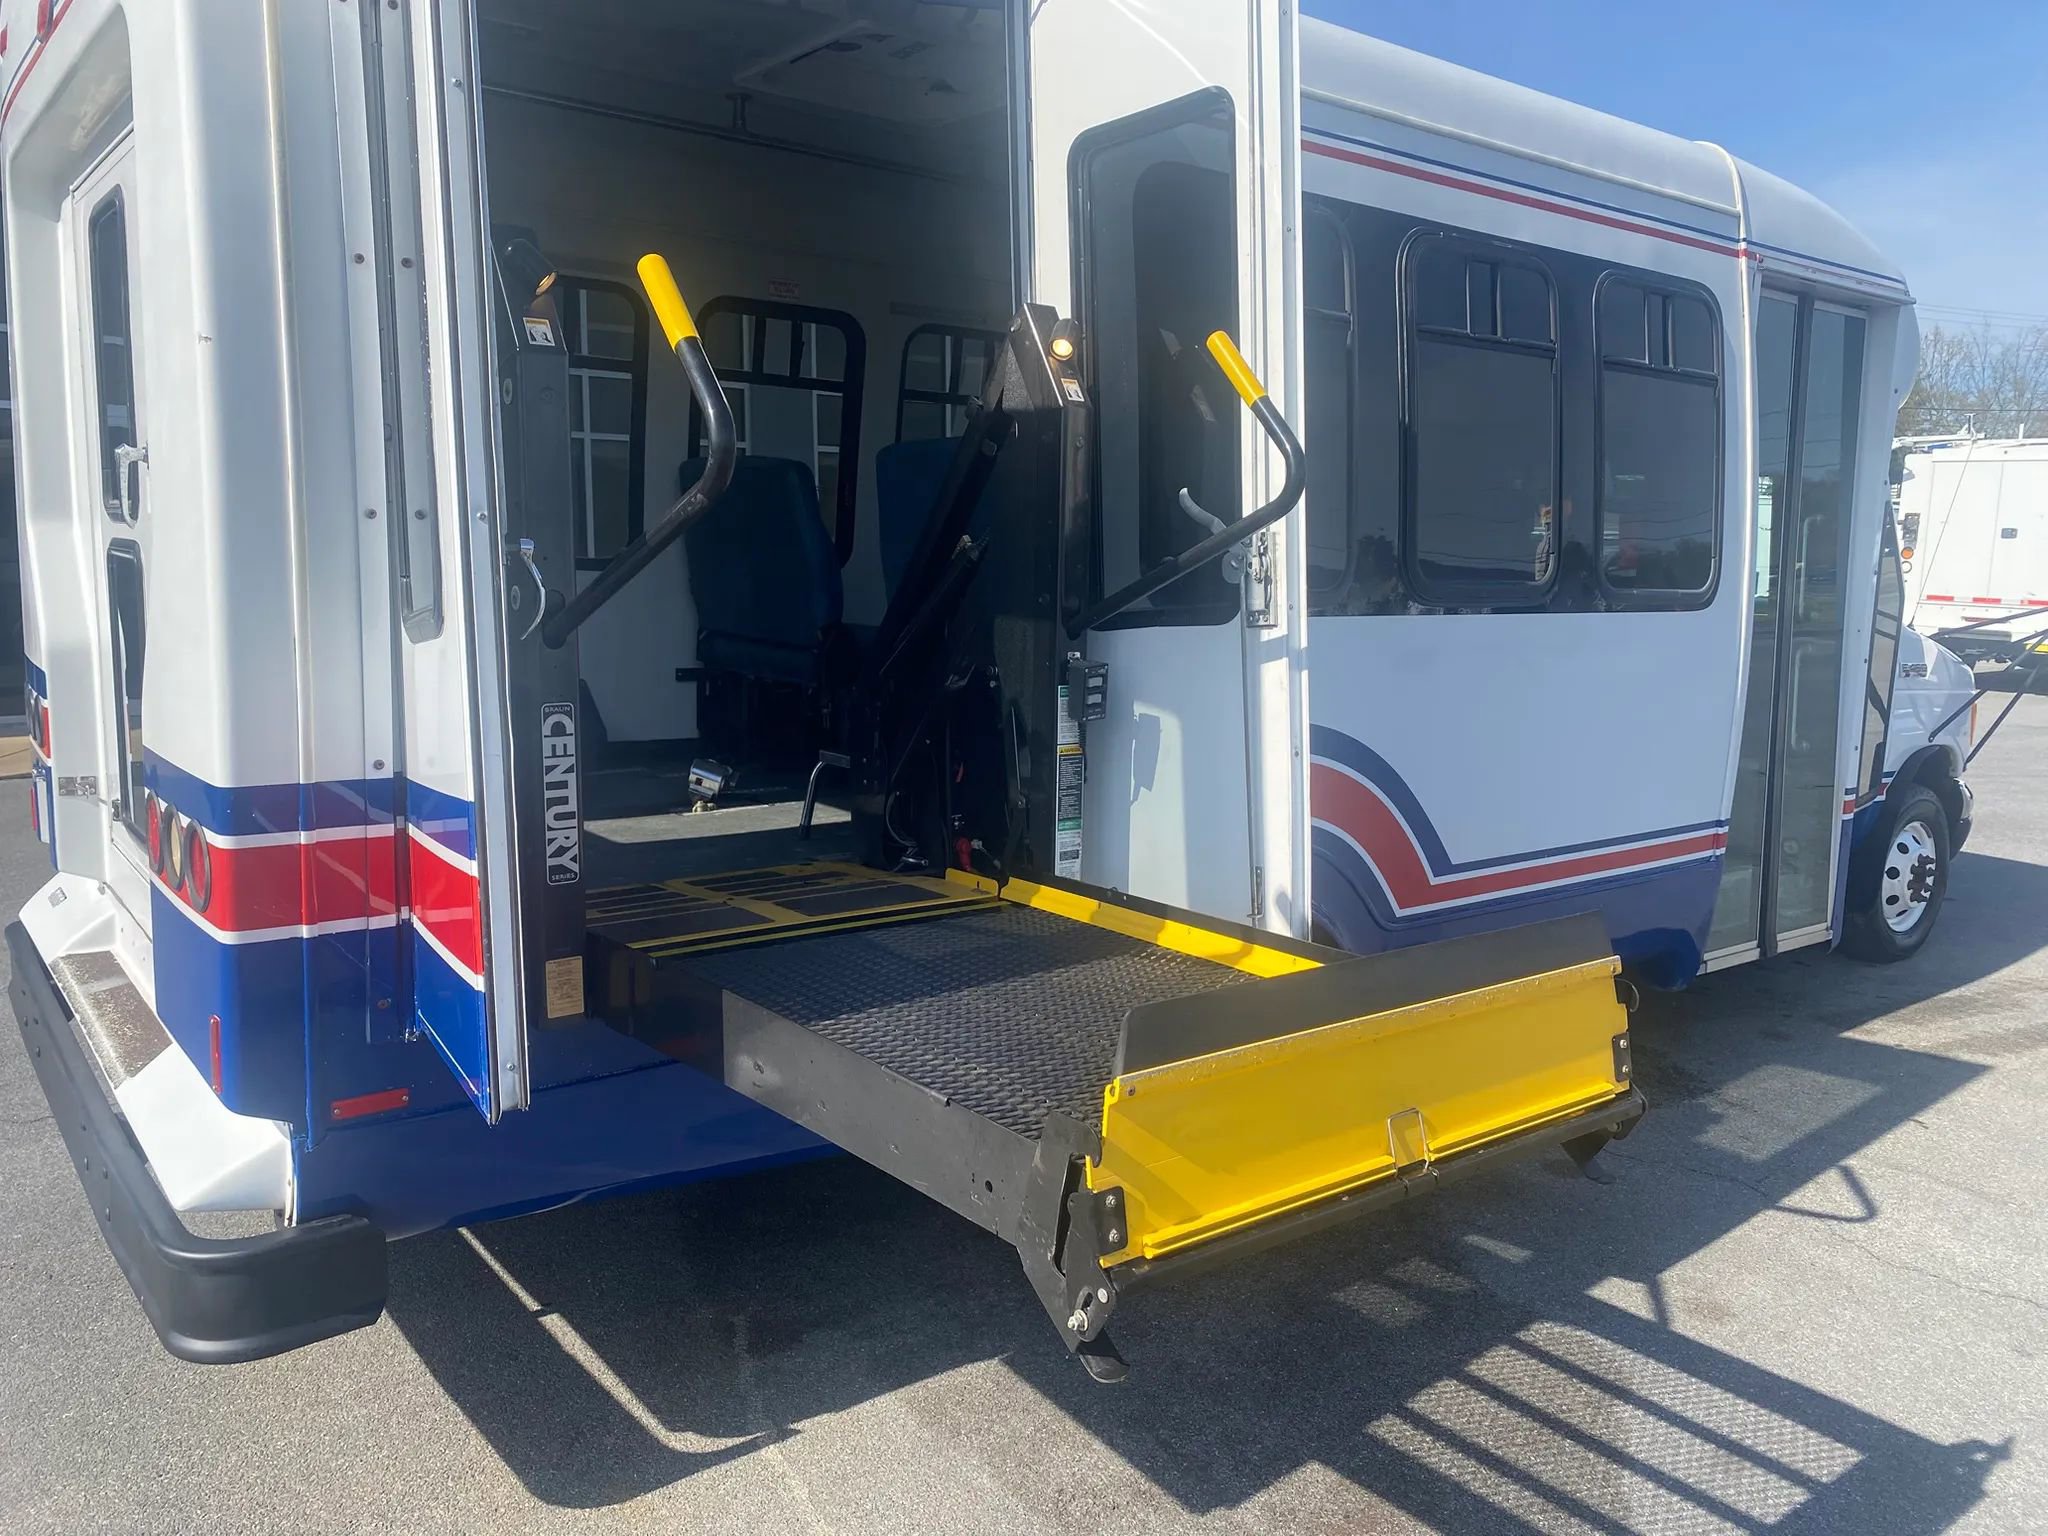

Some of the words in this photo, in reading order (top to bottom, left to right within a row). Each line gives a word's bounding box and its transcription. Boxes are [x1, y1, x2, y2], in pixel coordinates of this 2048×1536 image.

[544, 705, 571, 713] BRAUN
[543, 713, 578, 872] CENTURY
[551, 872, 576, 881] SERIES
